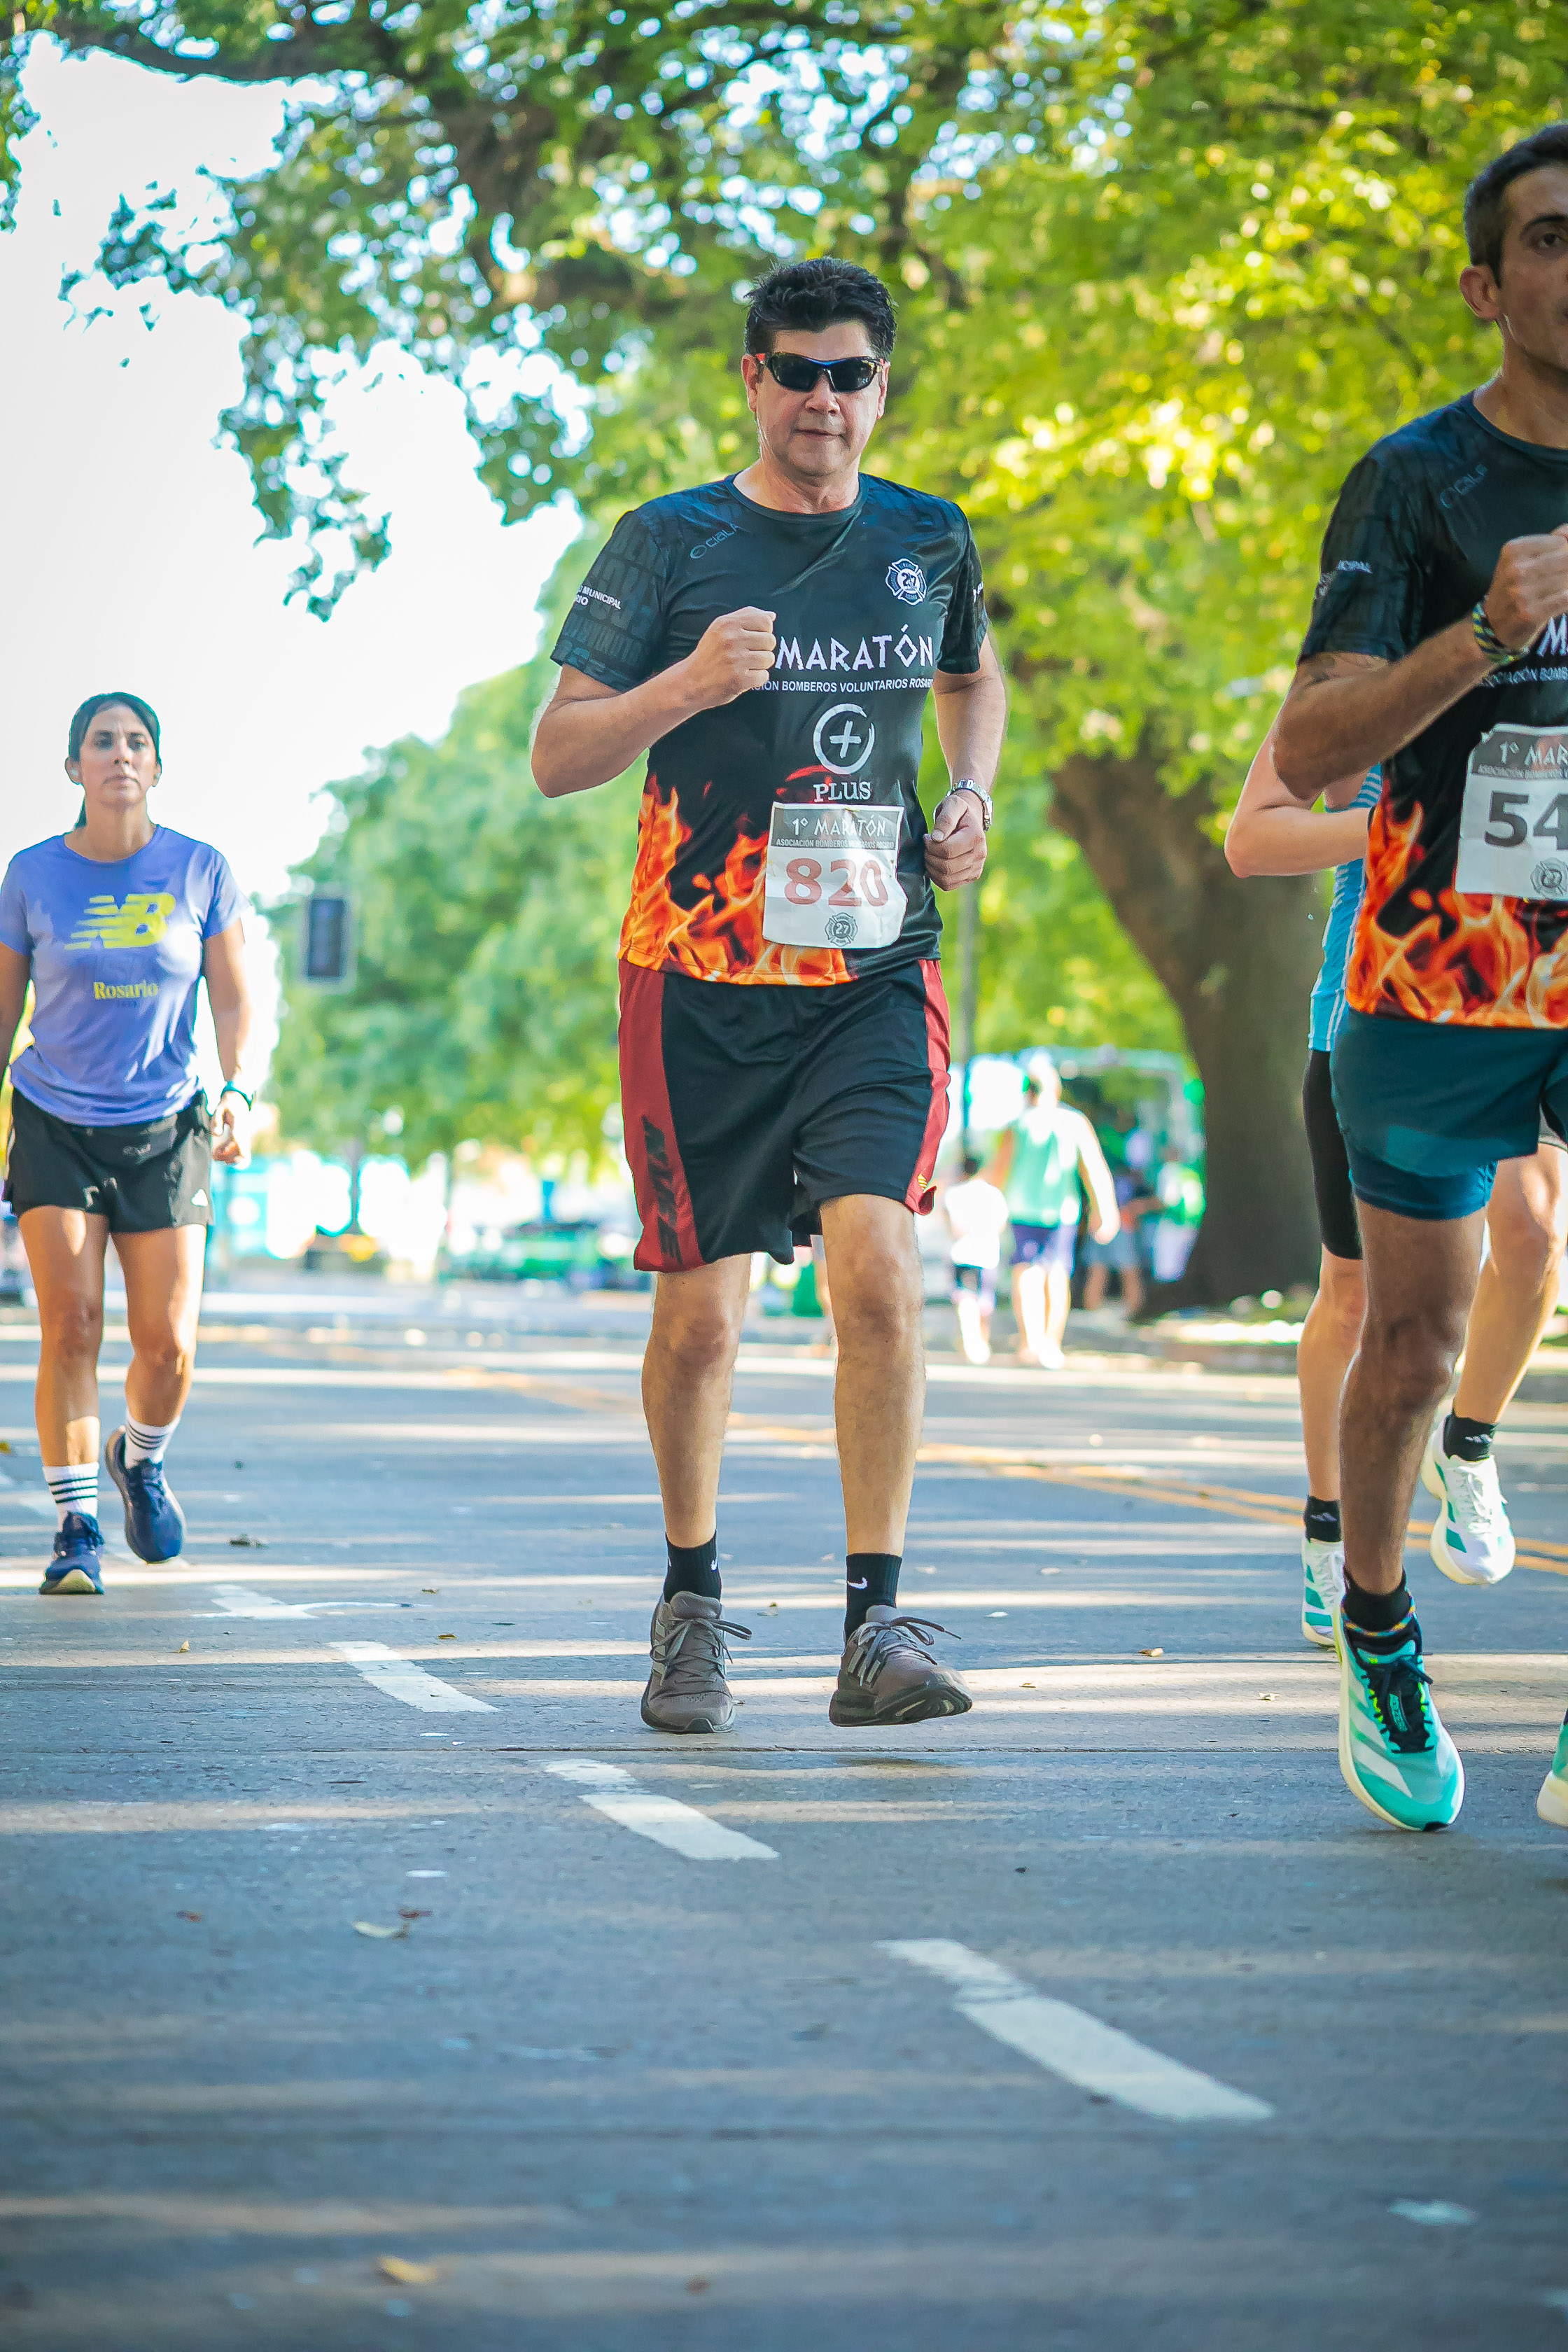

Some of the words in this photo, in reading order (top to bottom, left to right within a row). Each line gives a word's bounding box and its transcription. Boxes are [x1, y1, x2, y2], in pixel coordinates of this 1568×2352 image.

[901, 572, 916, 587] 27
[581, 585, 622, 610] MUNICIPAL
[774, 623, 934, 672] MARATÓN
[782, 680, 837, 692] BOMBEROS
[839, 678, 909, 693] VOLUNTARIOS
[813, 780, 871, 802] PLUS
[814, 815, 886, 836] MARATÓN
[1485, 790, 1568, 850] 54
[776, 838, 813, 848] ASOCIACIÓN
[816, 840, 848, 848] BOMBEROS
[784, 858, 888, 906] 820
[835, 922, 849, 934] 27
[93, 980, 159, 999] Rosario
